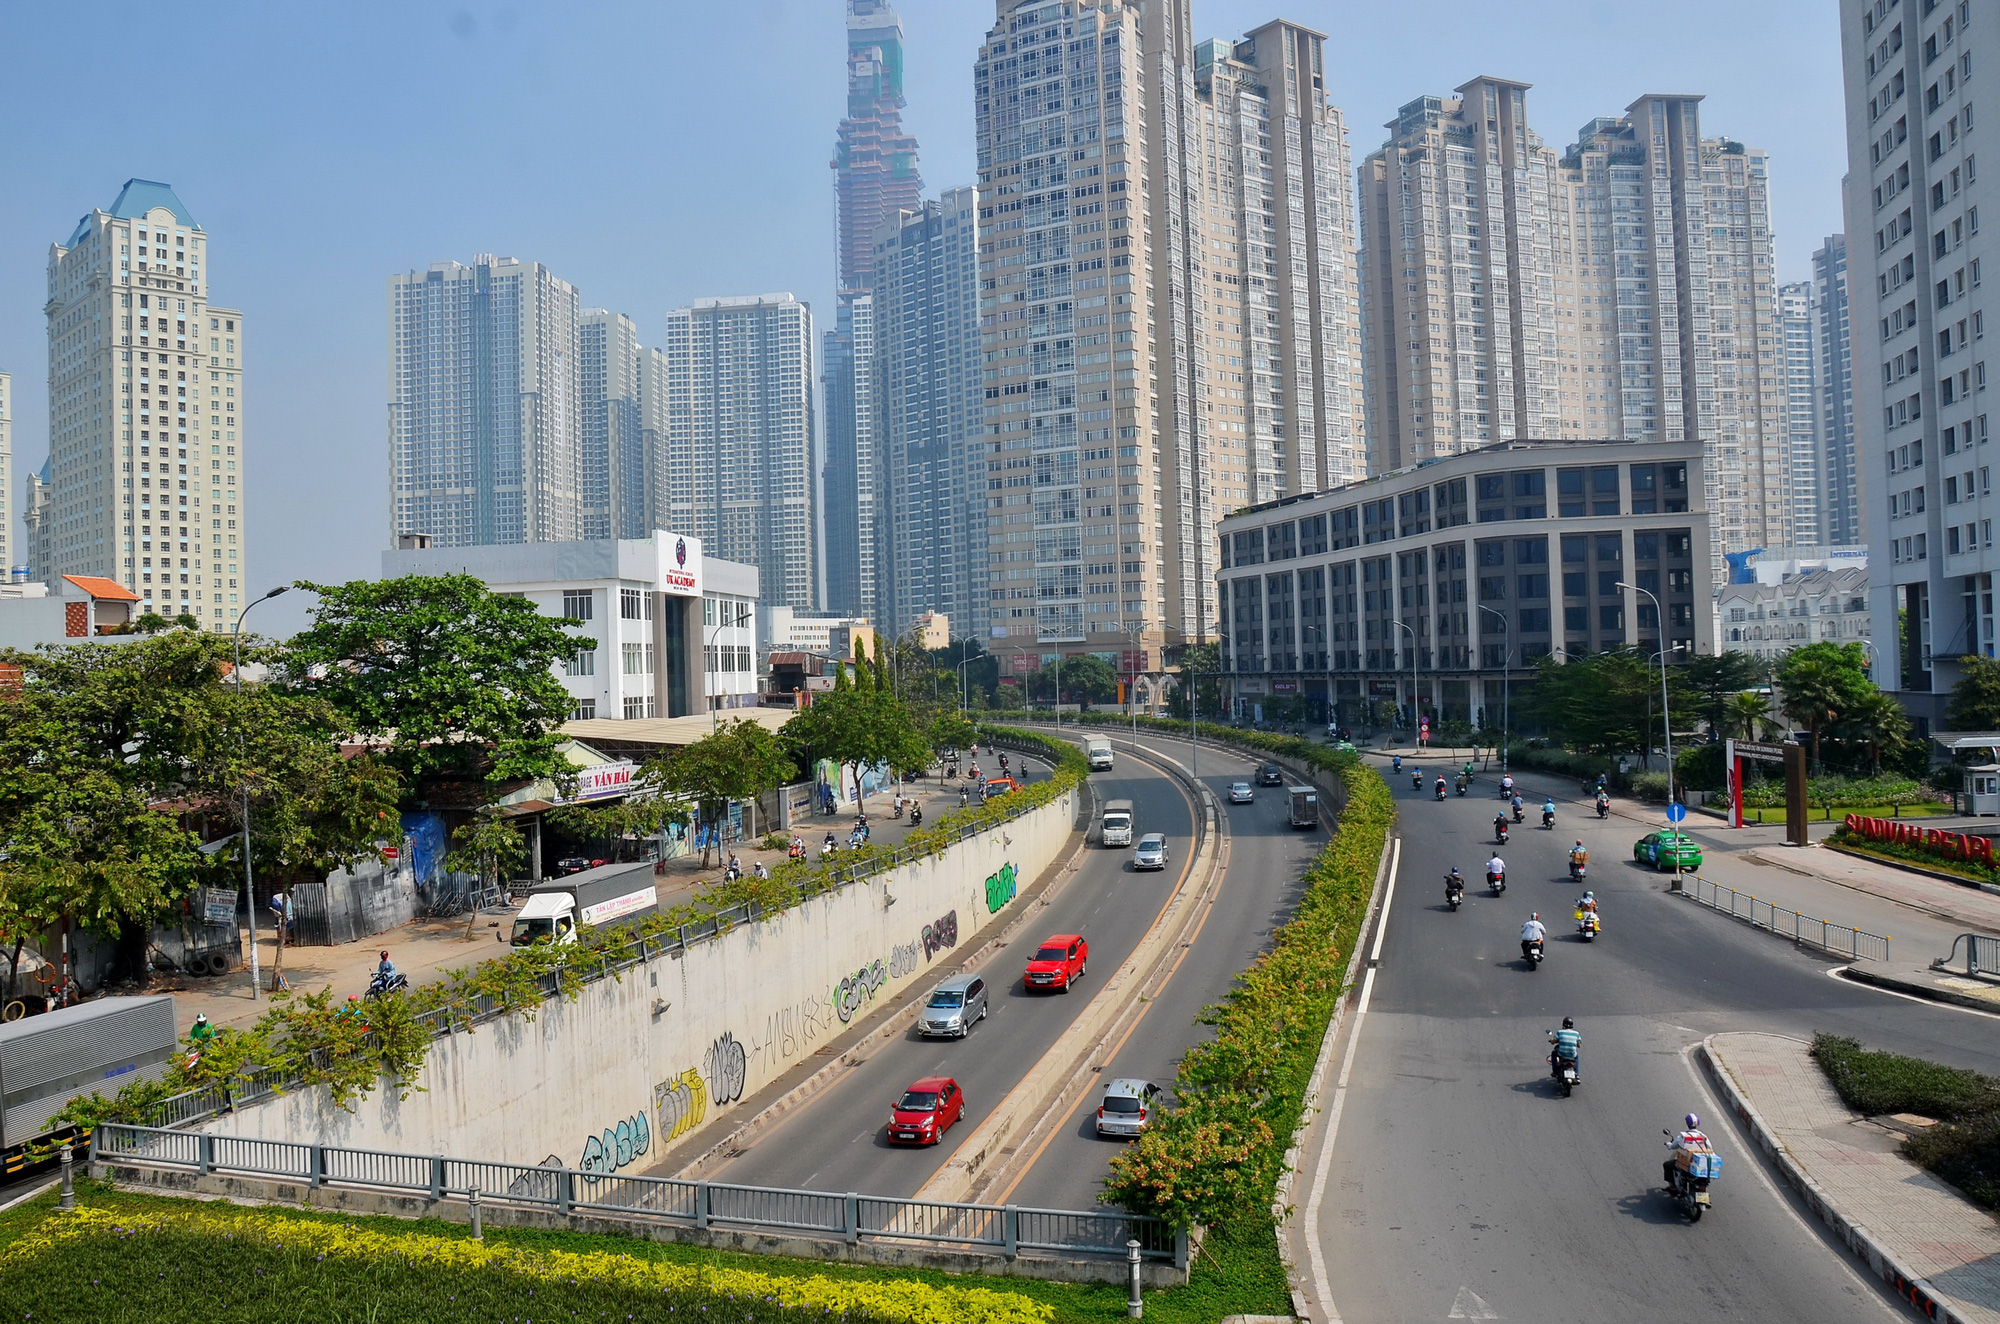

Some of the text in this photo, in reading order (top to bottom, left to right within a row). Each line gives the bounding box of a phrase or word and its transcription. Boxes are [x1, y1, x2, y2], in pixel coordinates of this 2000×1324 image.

[666, 574, 696, 588] UK ACADEMY
[594, 771, 613, 787] VĂN
[613, 767, 630, 785] HẢI
[1845, 813, 1998, 868] SUNWAH PEARL
